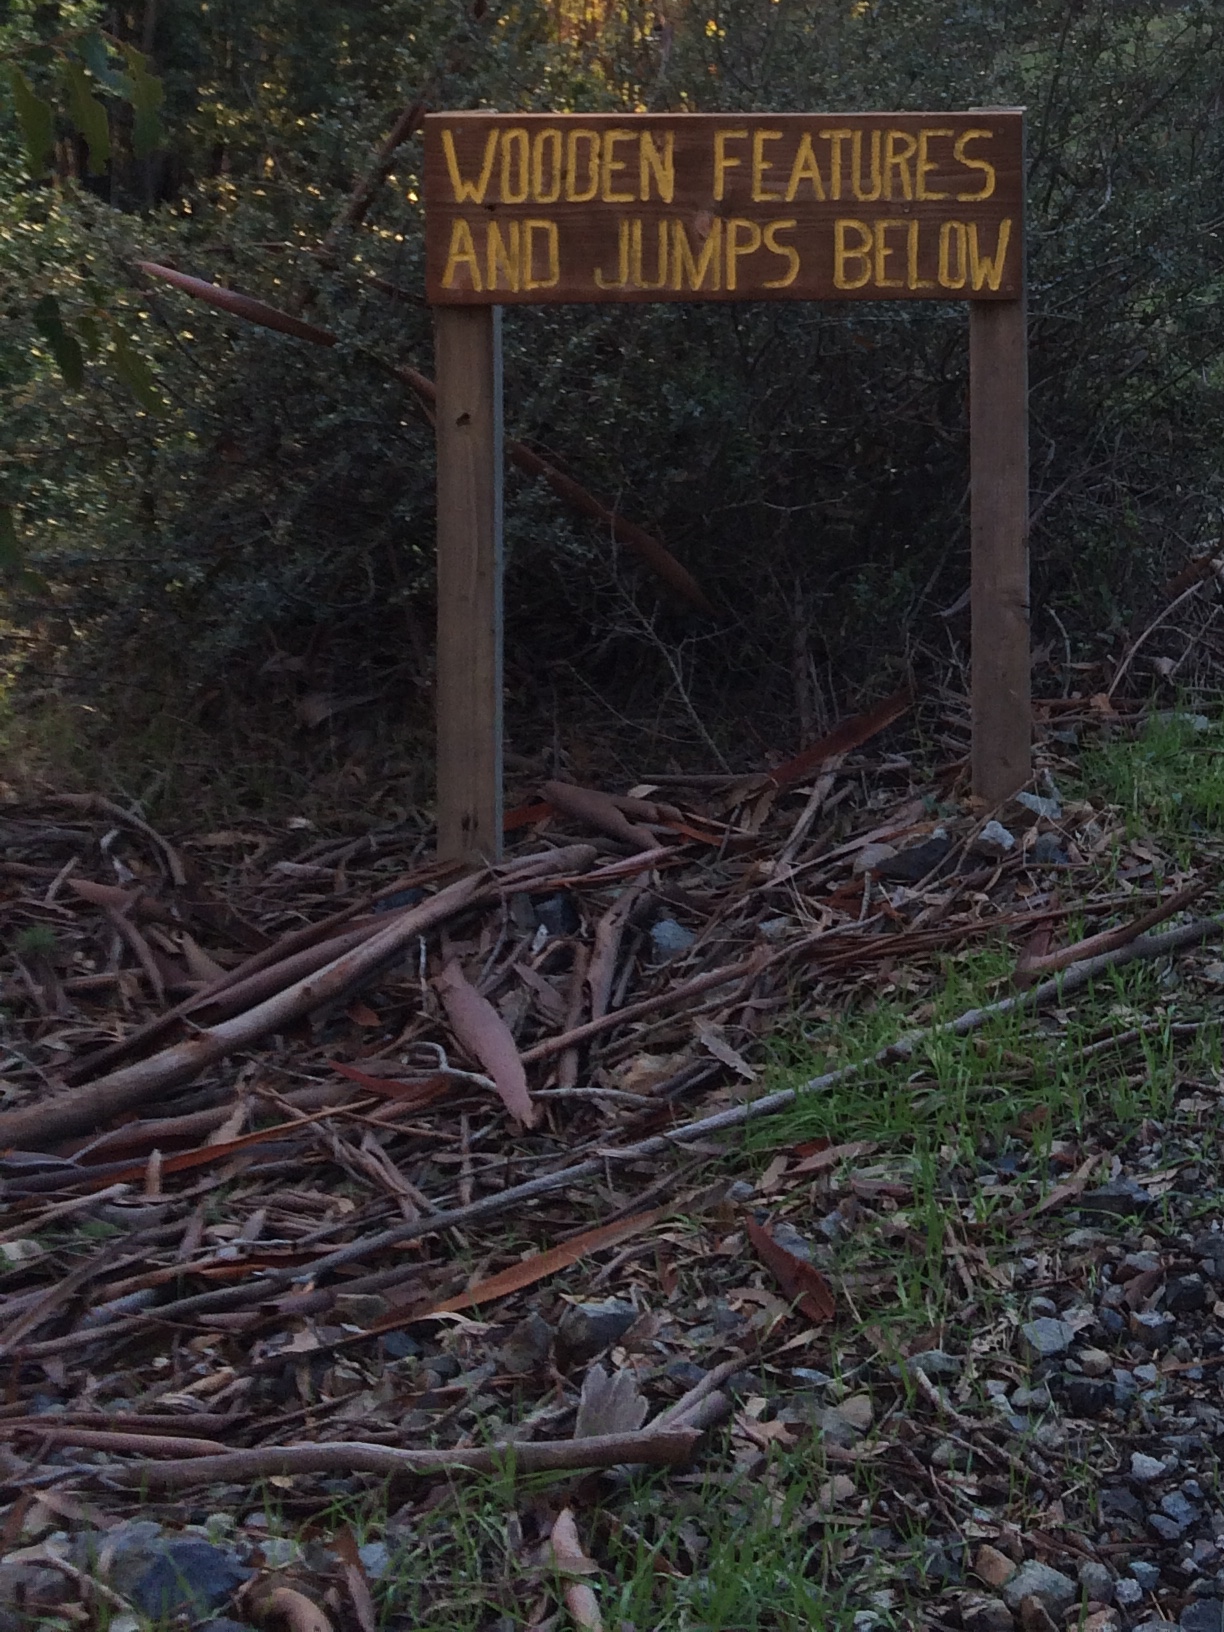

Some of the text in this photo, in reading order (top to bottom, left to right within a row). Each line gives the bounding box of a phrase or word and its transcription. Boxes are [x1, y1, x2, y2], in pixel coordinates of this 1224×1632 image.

[441, 128, 996, 204] WOODEN FEATURES
[441, 218, 1012, 292] AND JUMPS BELOW
